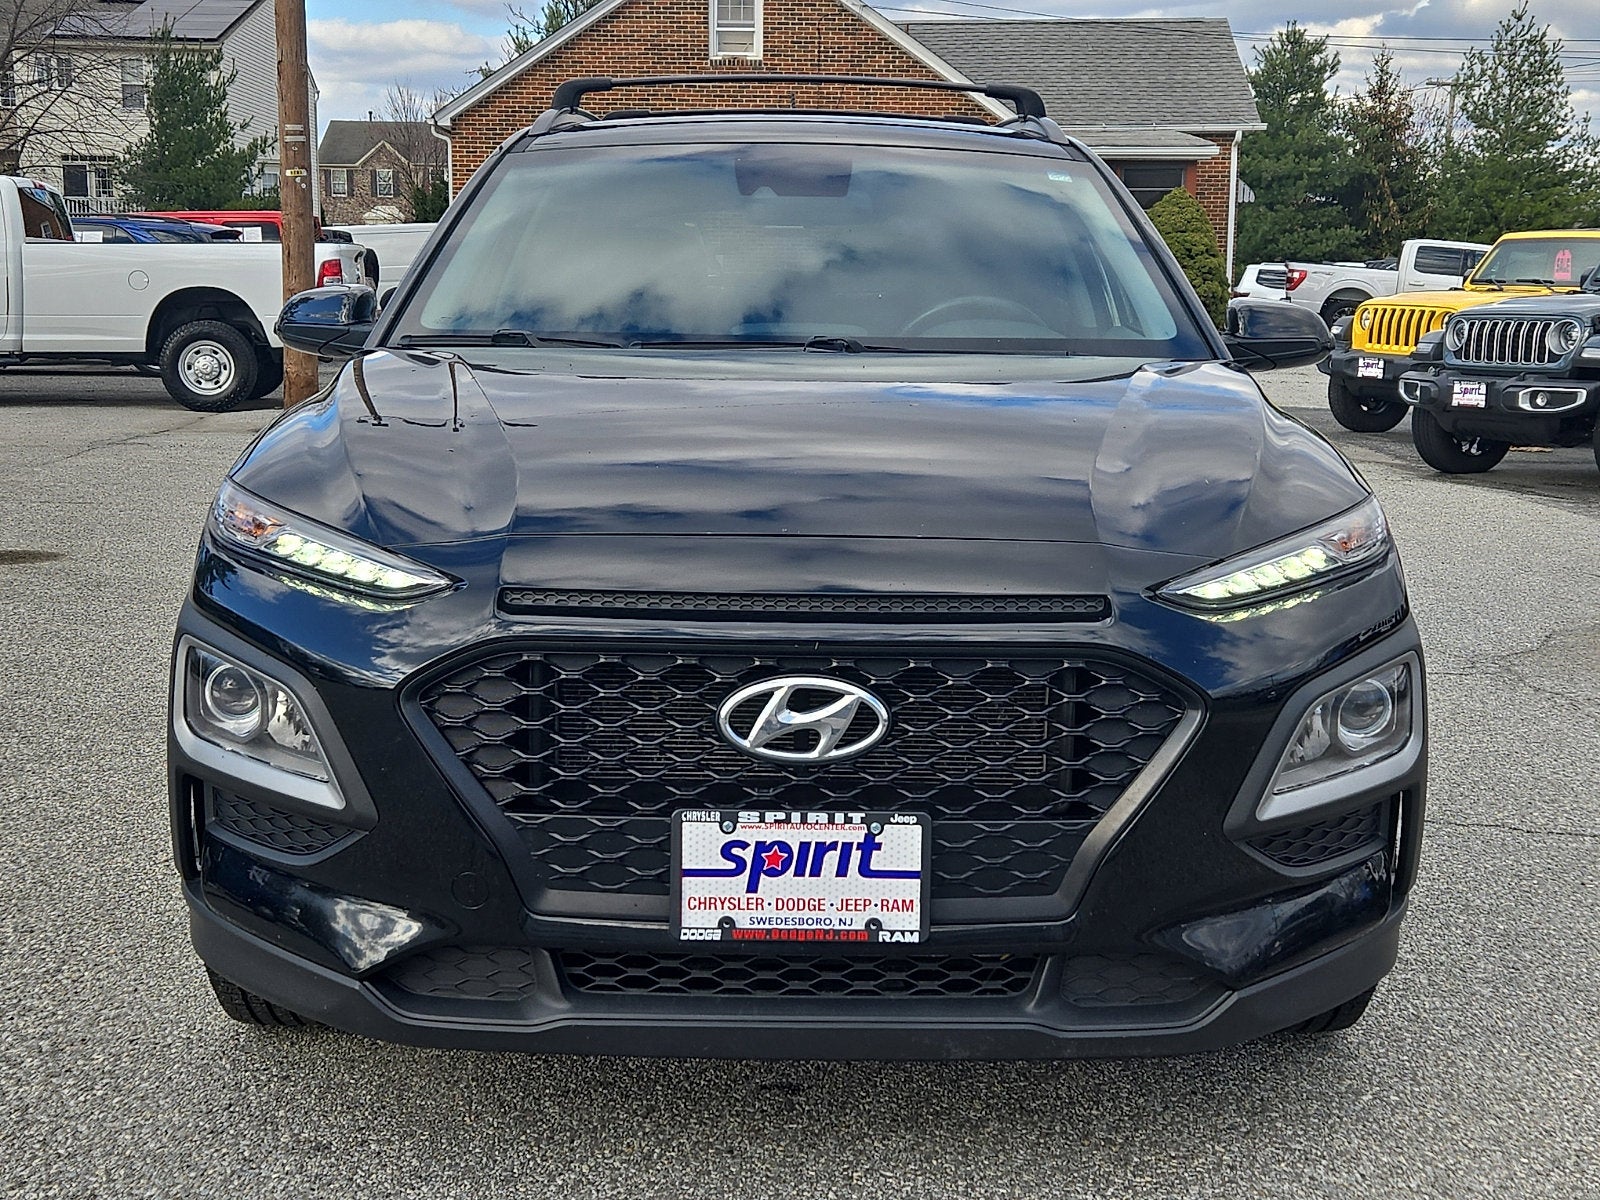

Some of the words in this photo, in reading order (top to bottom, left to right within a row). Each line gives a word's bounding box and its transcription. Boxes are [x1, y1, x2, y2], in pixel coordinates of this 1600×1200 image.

[681, 811, 721, 822] CHRYSLER
[737, 811, 866, 824] SPIRIT
[890, 813, 918, 825] Jeep
[740, 822, 866, 831] www.SPIRITAUTOCENTER.com
[719, 832, 883, 894] spirit
[687, 896, 765, 911] CHRYSLER
[775, 897, 826, 912] DODGE
[836, 898, 872, 912] JEEP
[880, 898, 915, 913] RAM
[748, 916, 836, 928] SWEDESBORO,
[838, 917, 854, 927] NJ
[680, 928, 722, 940] DODGE
[731, 928, 869, 941] www.DodgeNJ.com
[878, 931, 920, 943] RAM
